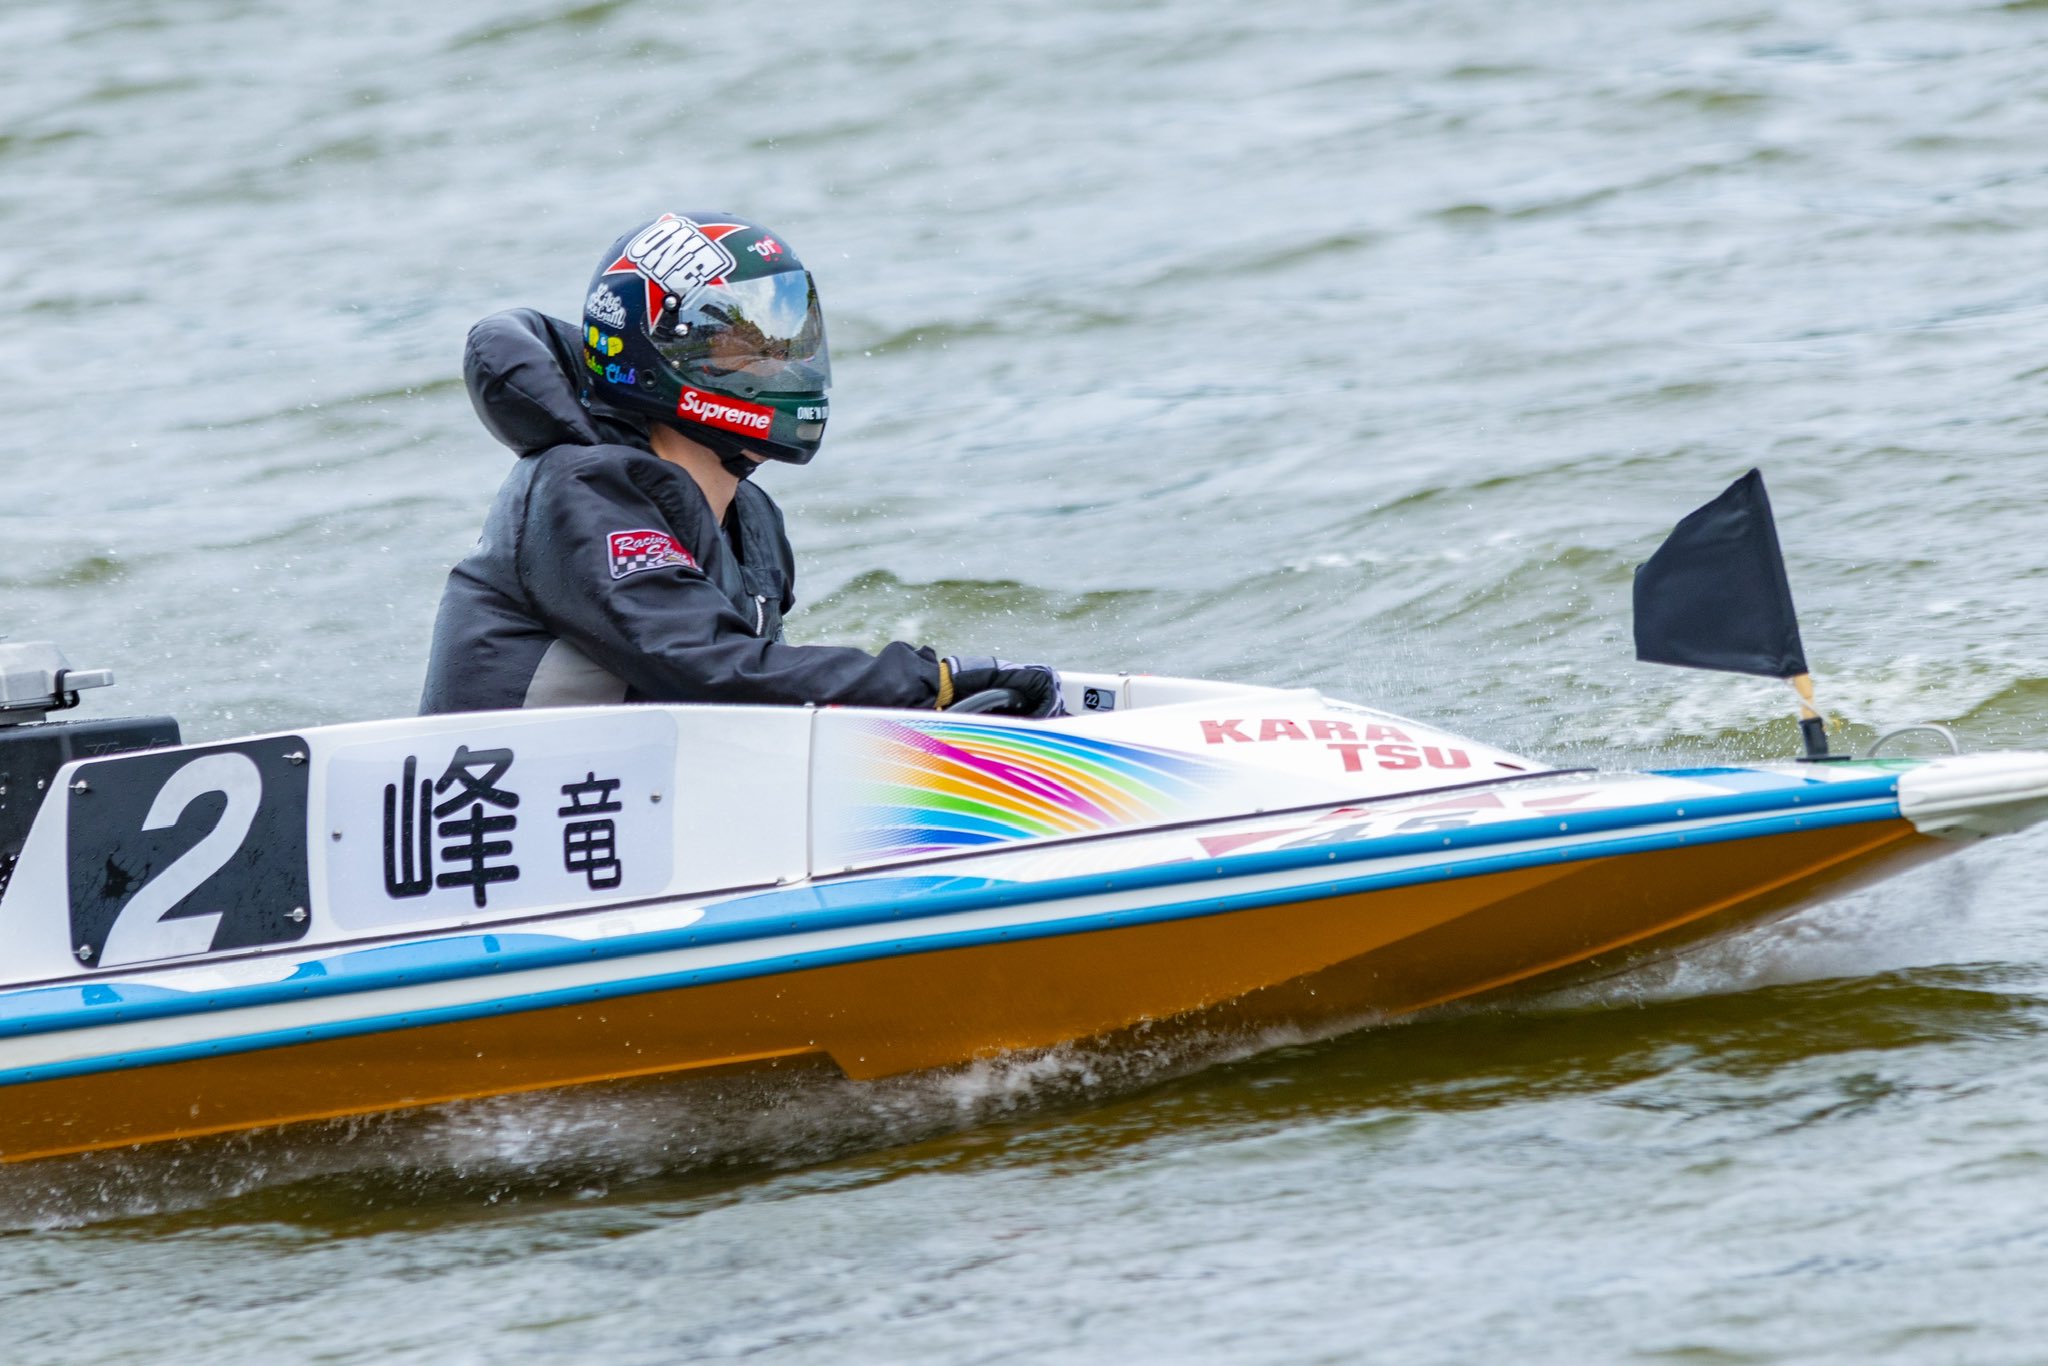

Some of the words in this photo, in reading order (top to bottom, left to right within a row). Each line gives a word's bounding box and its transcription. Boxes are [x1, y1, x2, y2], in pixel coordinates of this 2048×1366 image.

[628, 219, 727, 298] ONE
[680, 391, 771, 430] Supreme
[1085, 693, 1098, 706] 22
[1200, 719, 1413, 744] KARA
[1326, 743, 1472, 773] TSU
[98, 752, 263, 968] 2
